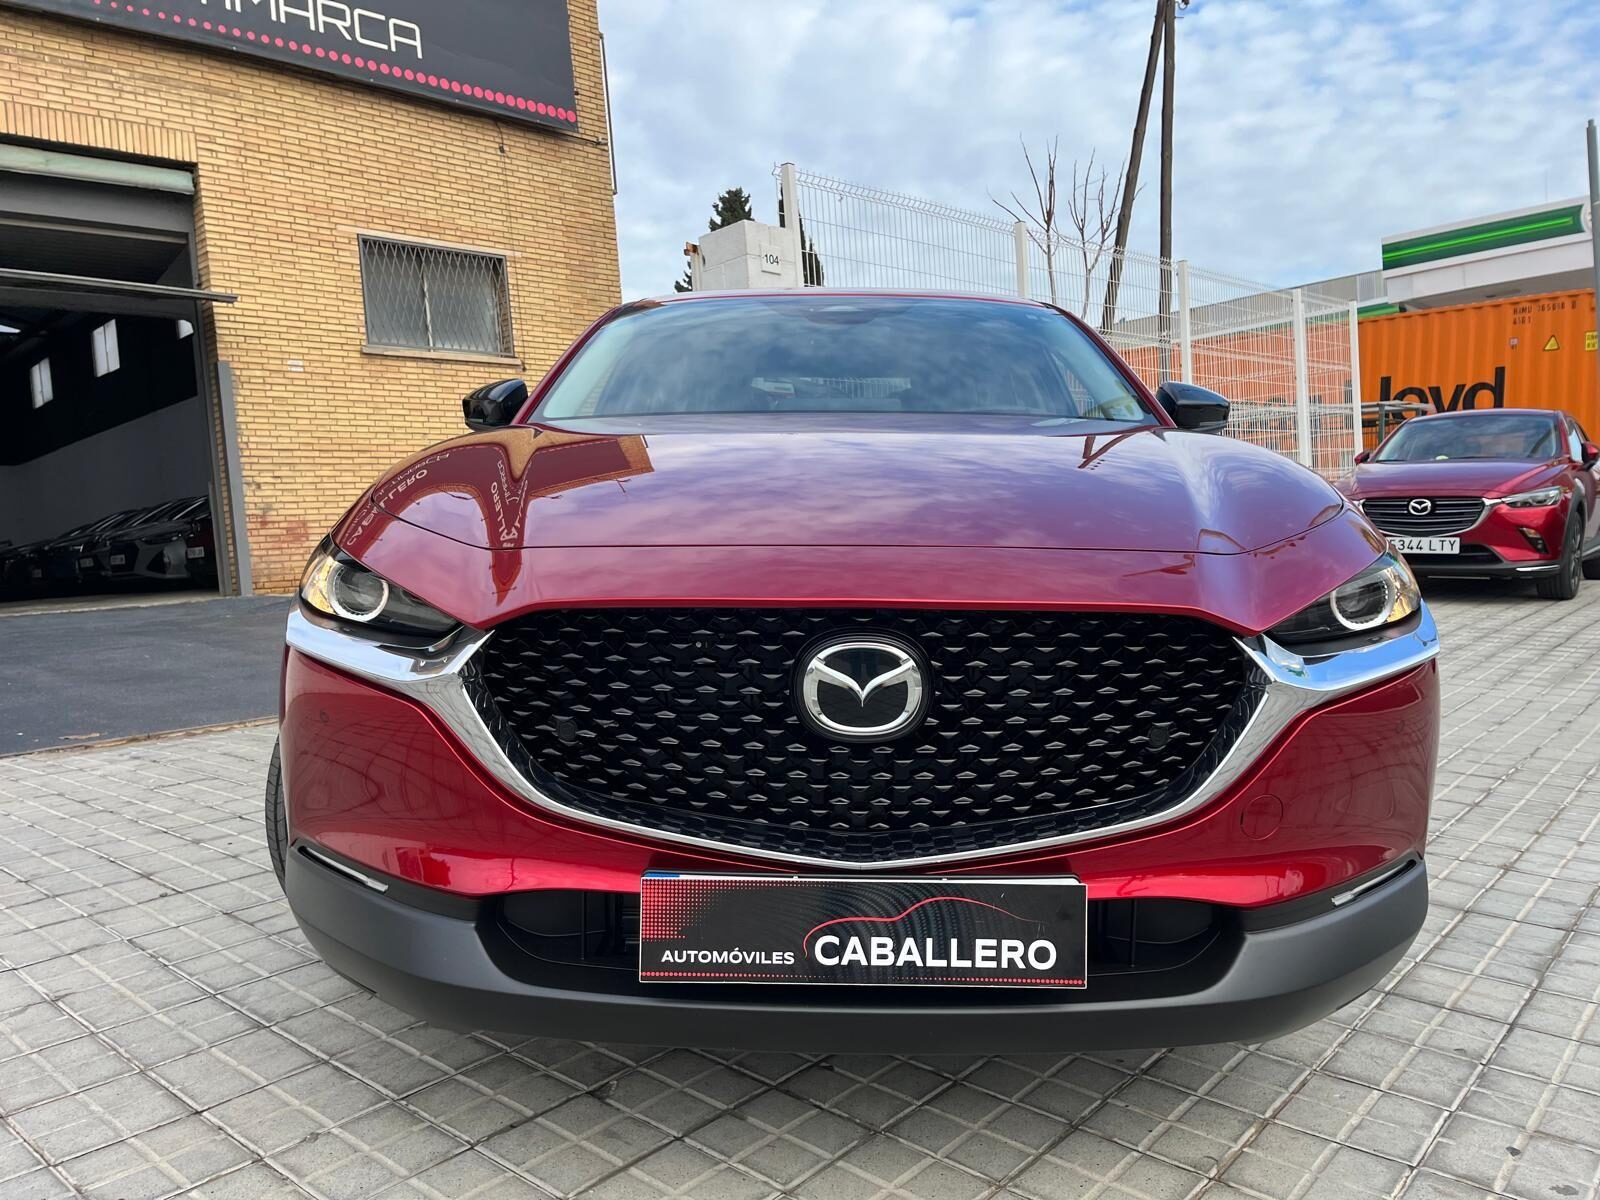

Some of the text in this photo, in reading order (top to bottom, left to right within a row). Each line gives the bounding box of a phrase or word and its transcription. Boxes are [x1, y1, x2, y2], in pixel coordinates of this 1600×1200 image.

[764, 254, 779, 265] 104
[1429, 540, 1456, 551] LTY
[661, 935, 1057, 970] AUTOMÓVILES CABALLERO
